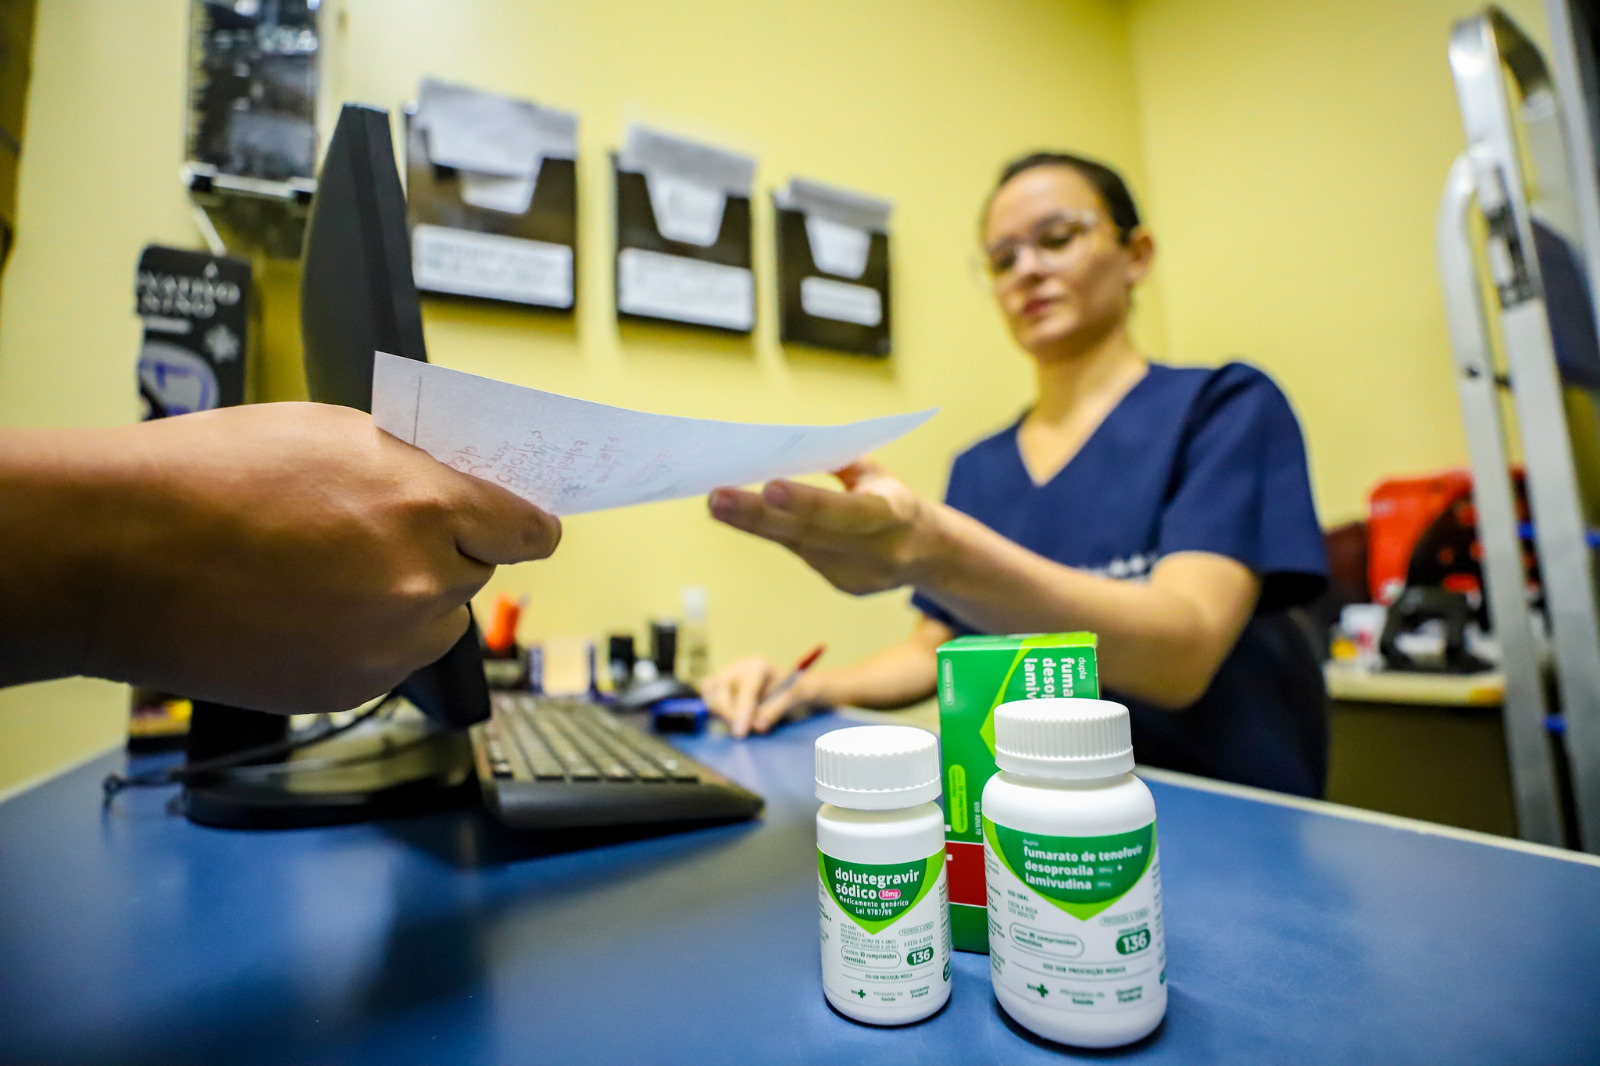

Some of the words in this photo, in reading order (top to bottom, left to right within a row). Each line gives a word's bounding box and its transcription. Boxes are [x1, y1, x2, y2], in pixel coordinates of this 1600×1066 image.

[1078, 656, 1087, 680] dupla
[973, 801, 981, 813] USO
[974, 814, 982, 836] ADULTO
[1023, 846, 1079, 863] fumarato
[1081, 851, 1096, 862] de
[1098, 844, 1143, 861] tenofovir
[1024, 860, 1094, 877] desoproxila
[835, 867, 920, 889] dolutegravir
[1025, 873, 1092, 890] lamivudina
[835, 882, 877, 899] sódico
[839, 896, 879, 908] Medicamento
[880, 899, 909, 910] genérico
[855, 907, 865, 915] Lei
[1122, 931, 1147, 953] 136
[911, 948, 931, 964] 136
